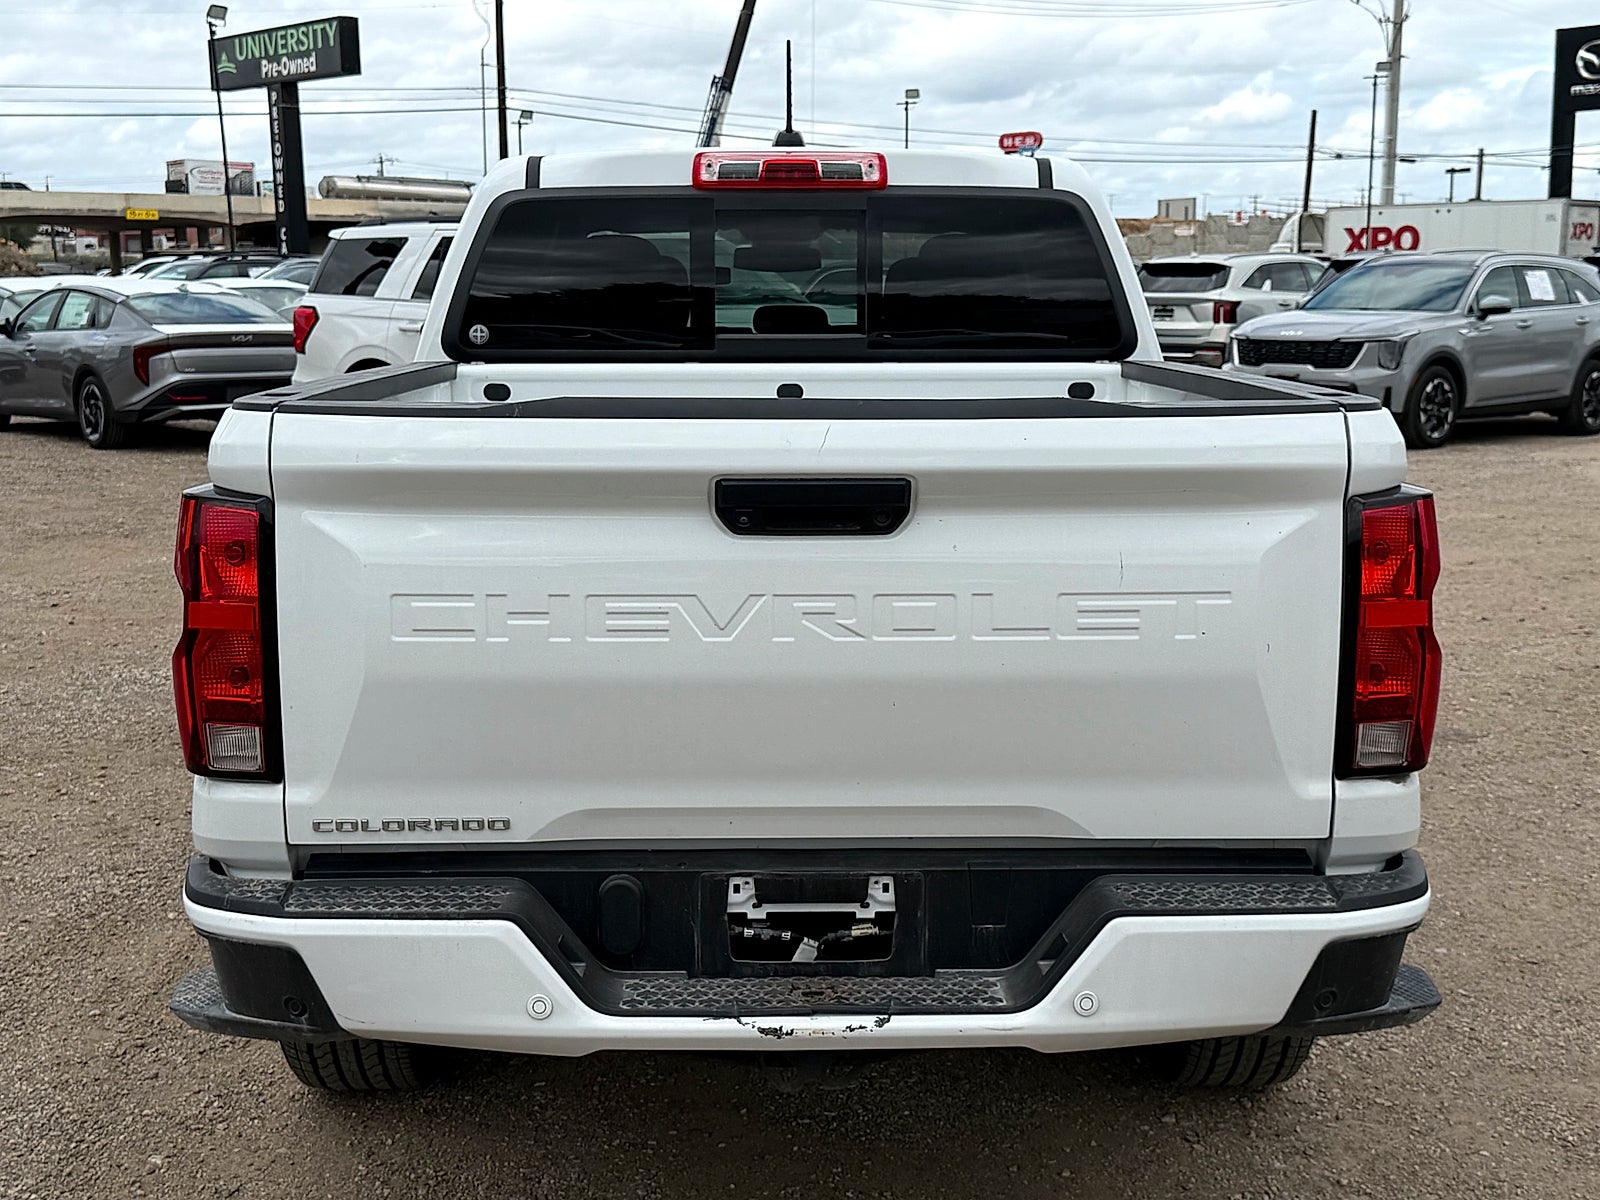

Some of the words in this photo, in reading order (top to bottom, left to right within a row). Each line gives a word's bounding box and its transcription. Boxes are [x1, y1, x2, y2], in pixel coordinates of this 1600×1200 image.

[234, 21, 338, 61] UNIVERSITY
[261, 51, 317, 79] Pre-Owned
[1344, 225, 1420, 253] XPO
[1570, 222, 1593, 240] XPO
[391, 591, 1232, 644] CHEVROLET
[312, 817, 510, 832] COLORADO
